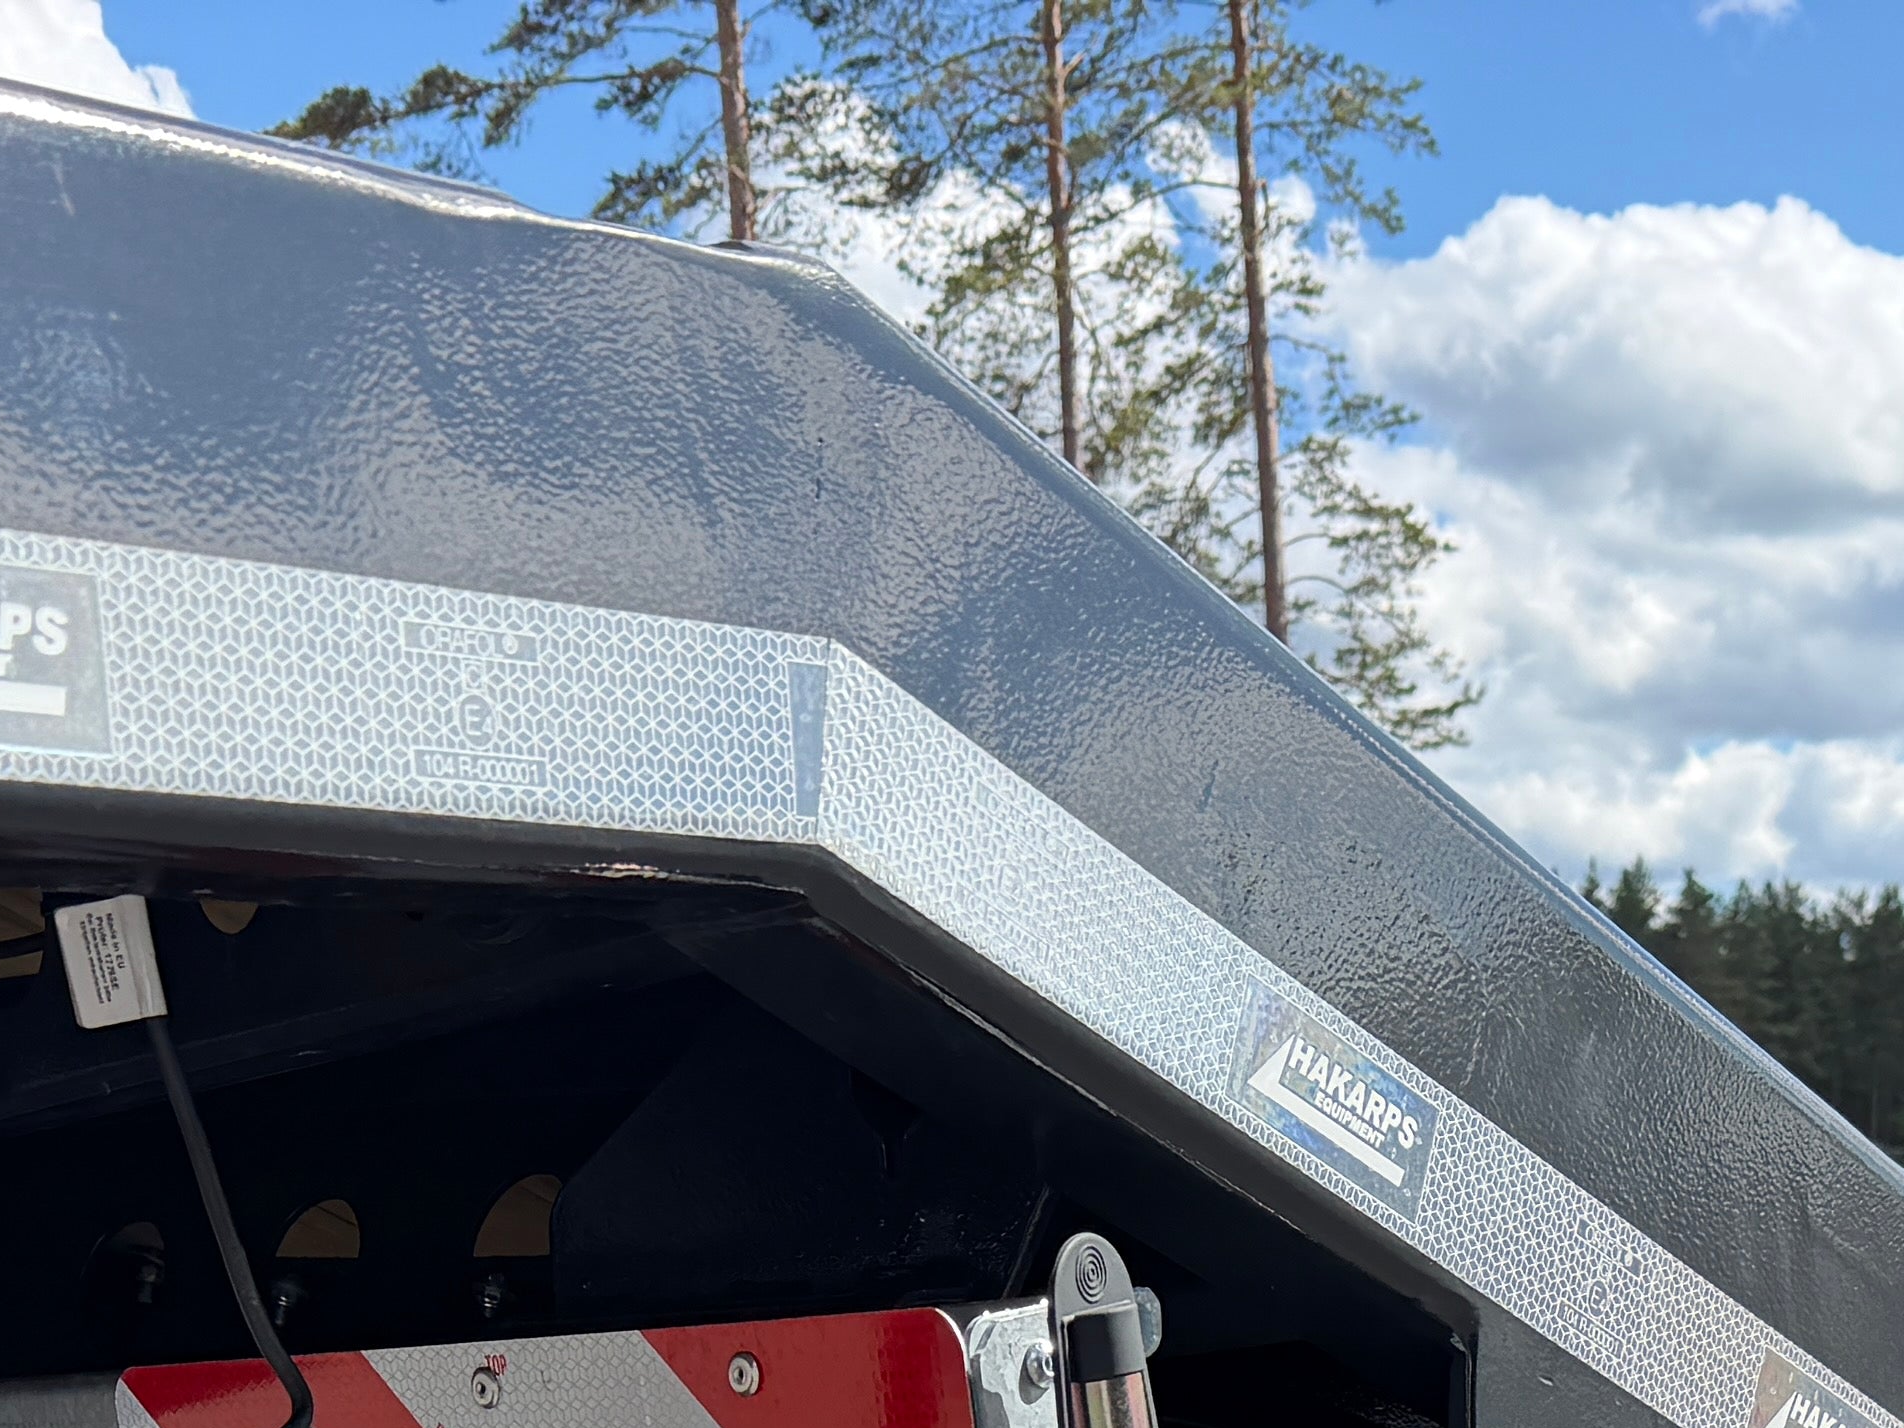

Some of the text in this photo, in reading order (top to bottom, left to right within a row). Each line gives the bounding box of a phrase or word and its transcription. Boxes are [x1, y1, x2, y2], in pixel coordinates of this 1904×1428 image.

[1288, 1038, 1418, 1149] HAKARPS
[1315, 1091, 1386, 1148] EQUIPMENT
[485, 1354, 507, 1376] TOP
